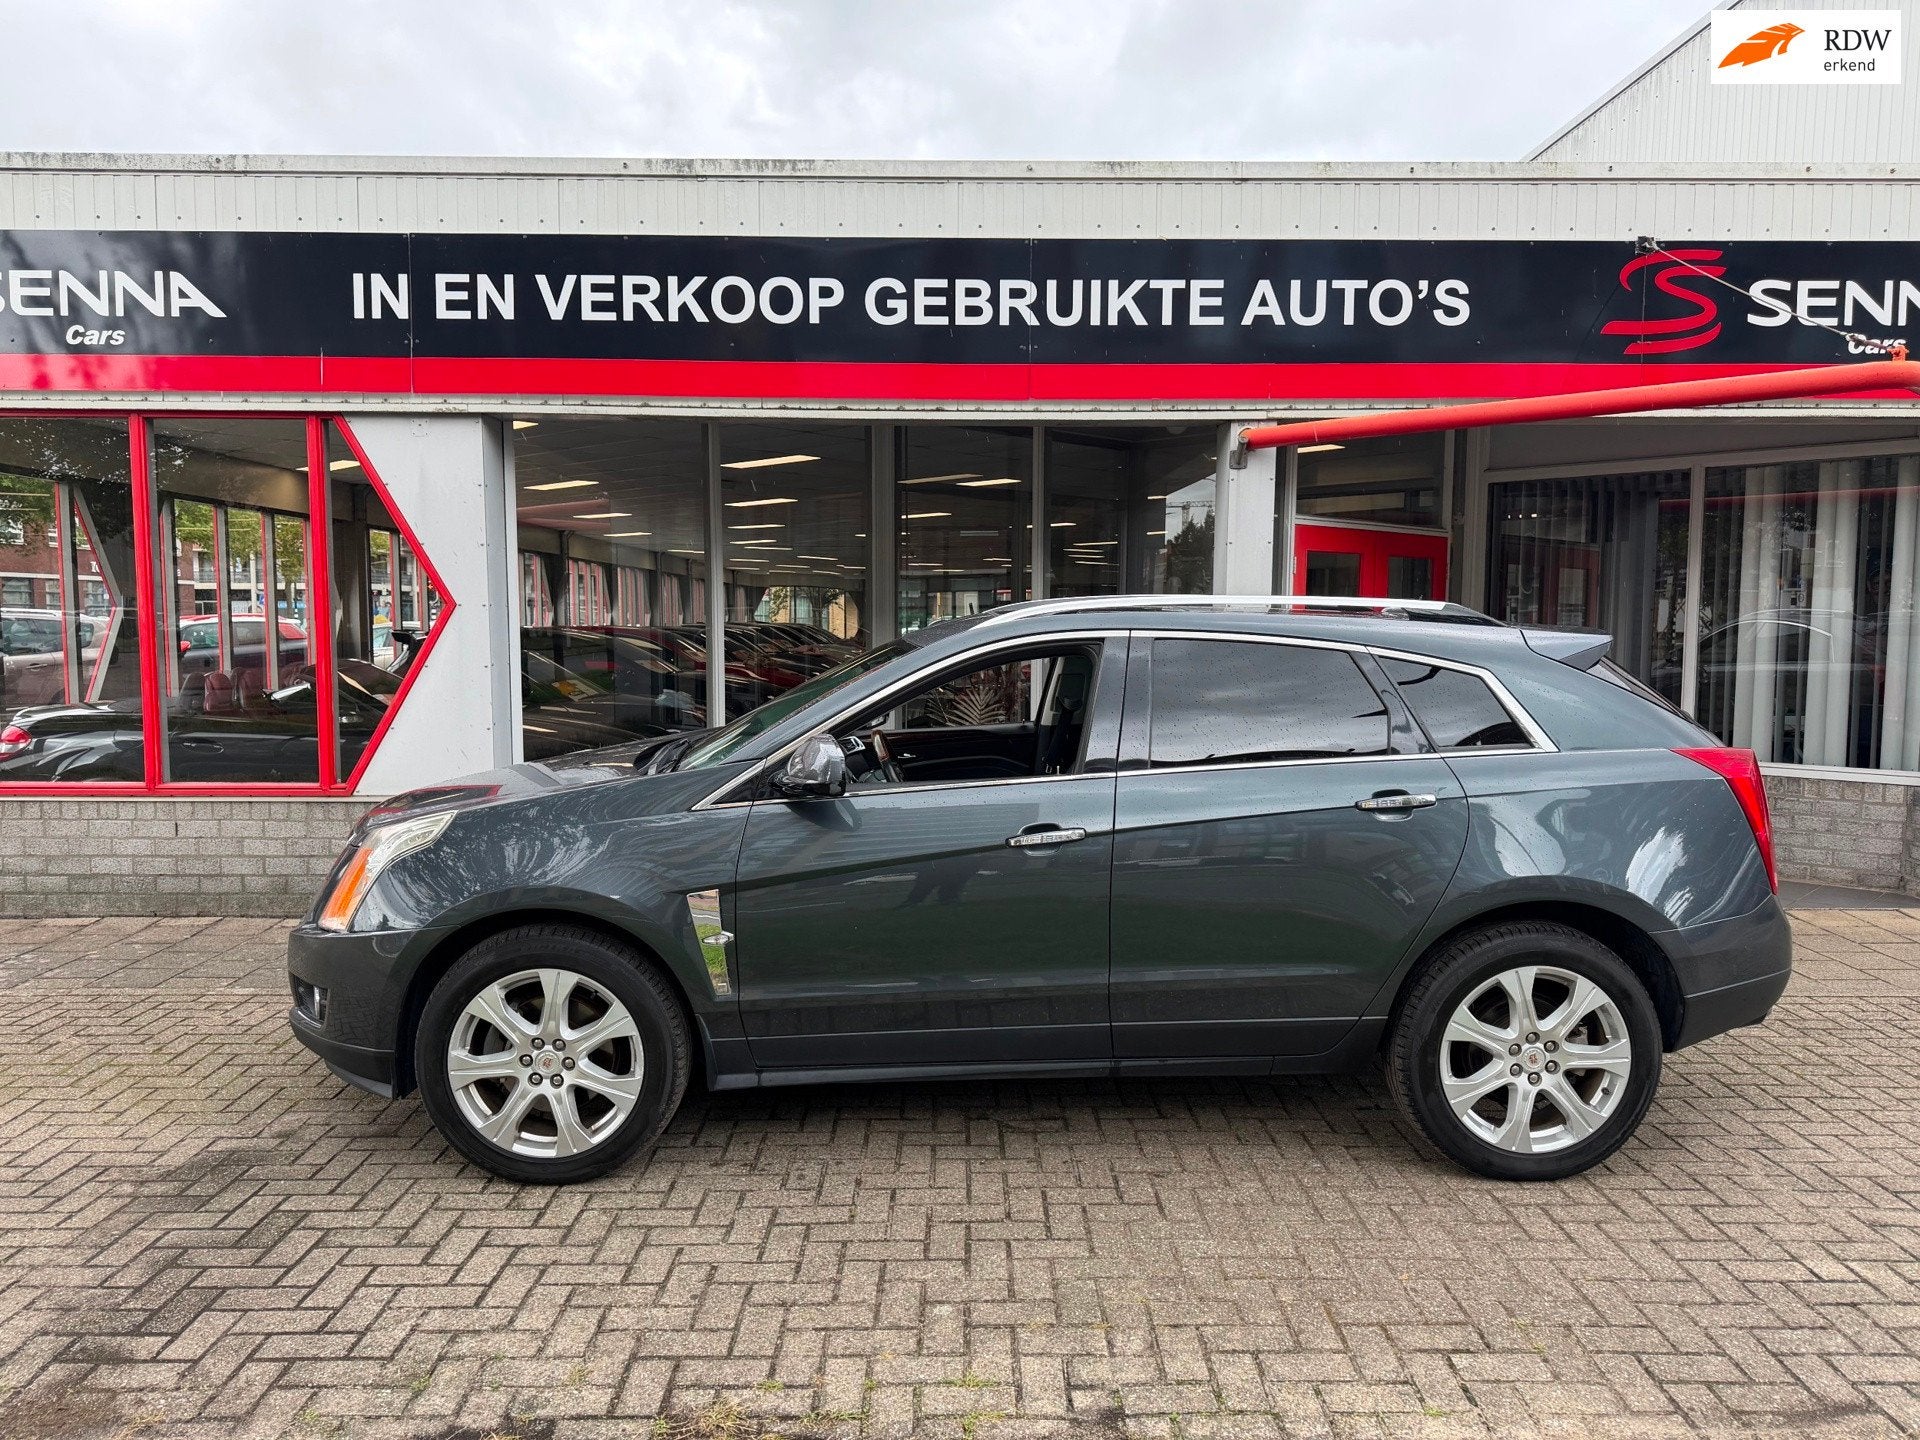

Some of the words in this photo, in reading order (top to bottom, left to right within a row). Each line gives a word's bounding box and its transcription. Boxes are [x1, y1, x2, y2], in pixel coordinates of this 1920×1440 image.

[0, 269, 227, 318] ENNA
[352, 273, 409, 320] IN
[435, 273, 515, 320] EN
[534, 273, 845, 324] VERKOOP
[864, 277, 1225, 327] GEBRUIKTE
[1240, 279, 1470, 327] AUTO’S
[65, 324, 126, 346] Cars
